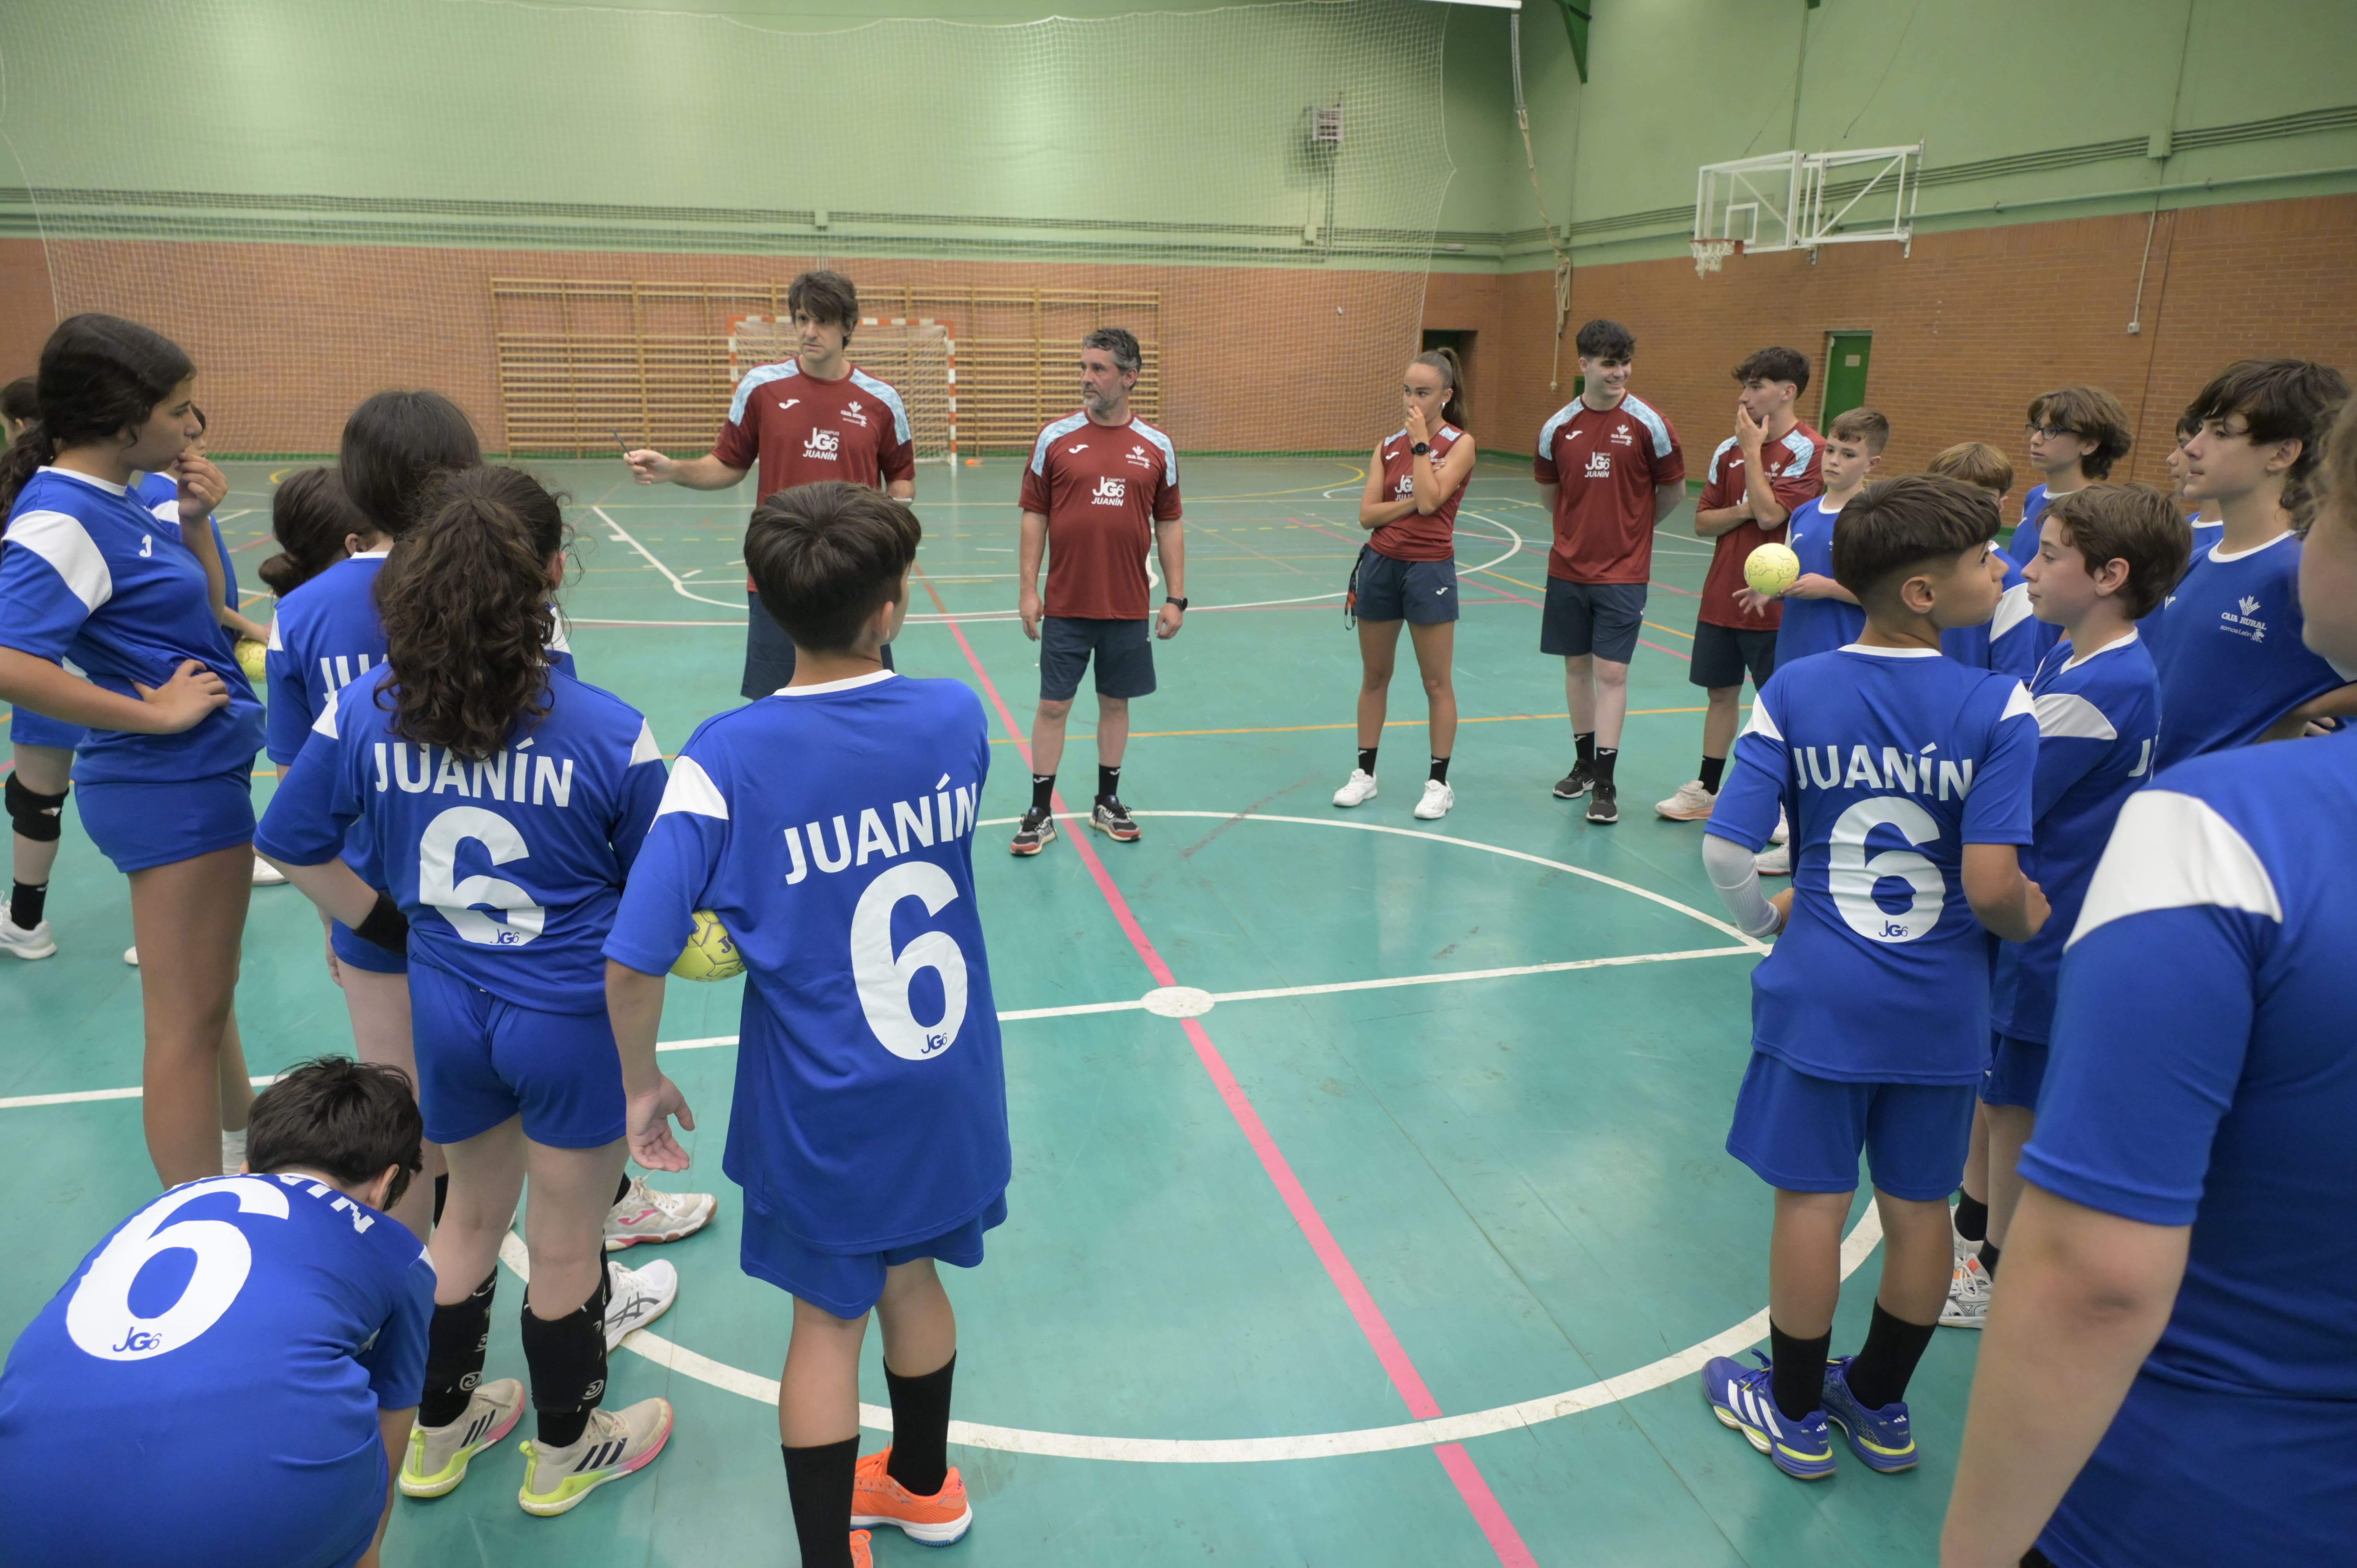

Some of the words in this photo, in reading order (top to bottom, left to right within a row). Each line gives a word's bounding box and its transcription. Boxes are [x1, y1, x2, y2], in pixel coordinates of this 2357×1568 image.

[804, 427, 839, 451] JG6
[802, 449, 837, 461] JUANÍN
[1585, 452, 1610, 470] JG6
[1092, 476, 1125, 497] JG6
[1394, 474, 1413, 493] JG
[1091, 496, 1124, 506] JUANÍN
[2220, 625, 2239, 634] somos
[2238, 629, 2252, 637] León
[2221, 612, 2238, 623] CAJA
[2239, 617, 2267, 630] RURAL
[375, 736, 573, 807] JUANÍN
[1793, 742, 1973, 801] JUANÍN
[783, 773, 976, 885] JUANÍN
[419, 806, 545, 946] 6
[1828, 796, 1946, 943] 6
[490, 929, 520, 944] JG6
[1878, 920, 1908, 938] JG6
[850, 861, 968, 1060] 6
[921, 1033, 947, 1054] JG6
[66, 1177, 289, 1361] 6
[113, 1326, 163, 1352] JG6
